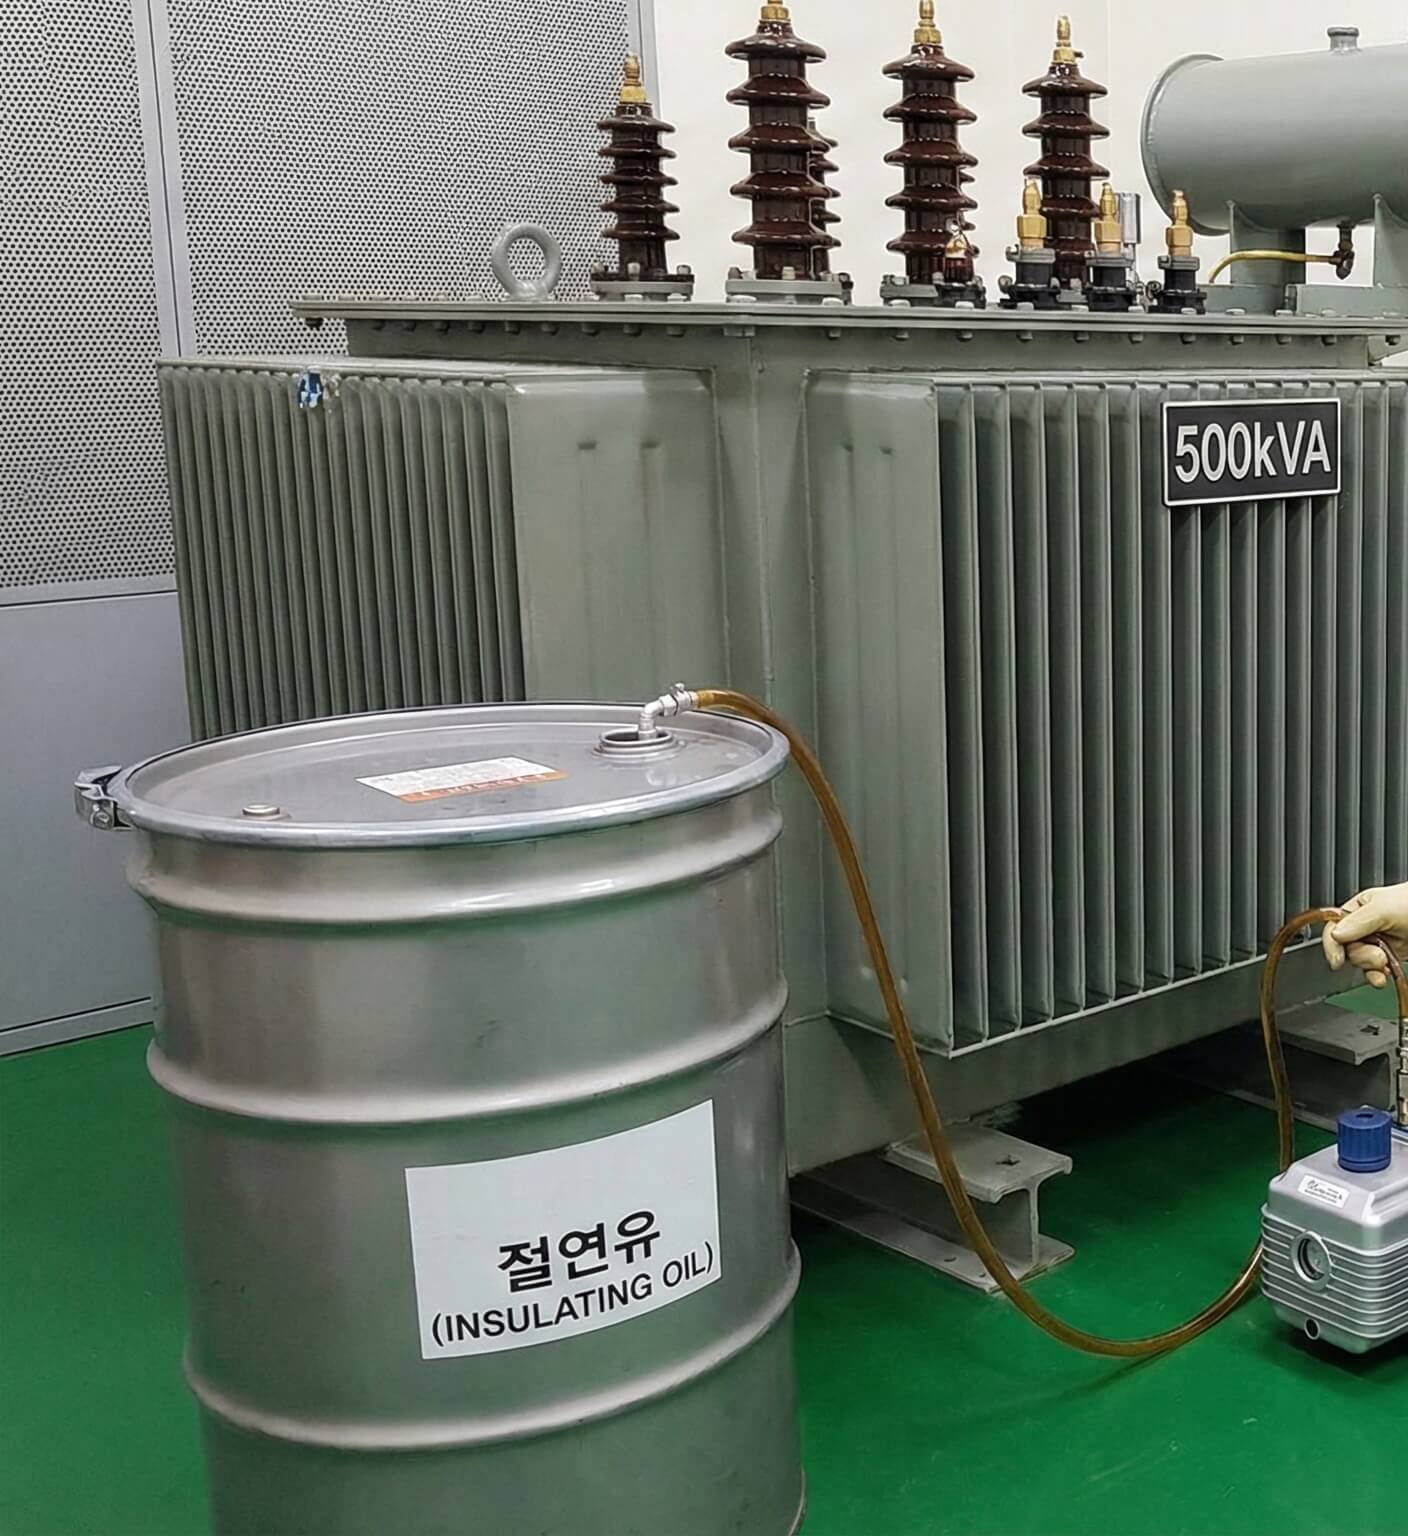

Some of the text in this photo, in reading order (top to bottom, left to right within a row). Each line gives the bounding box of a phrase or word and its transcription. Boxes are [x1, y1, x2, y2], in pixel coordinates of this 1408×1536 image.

[1175, 420, 1331, 483] 500kVA
[498, 1210, 660, 1292] 절연유
[432, 1241, 713, 1347] (INSULATING OIL)
